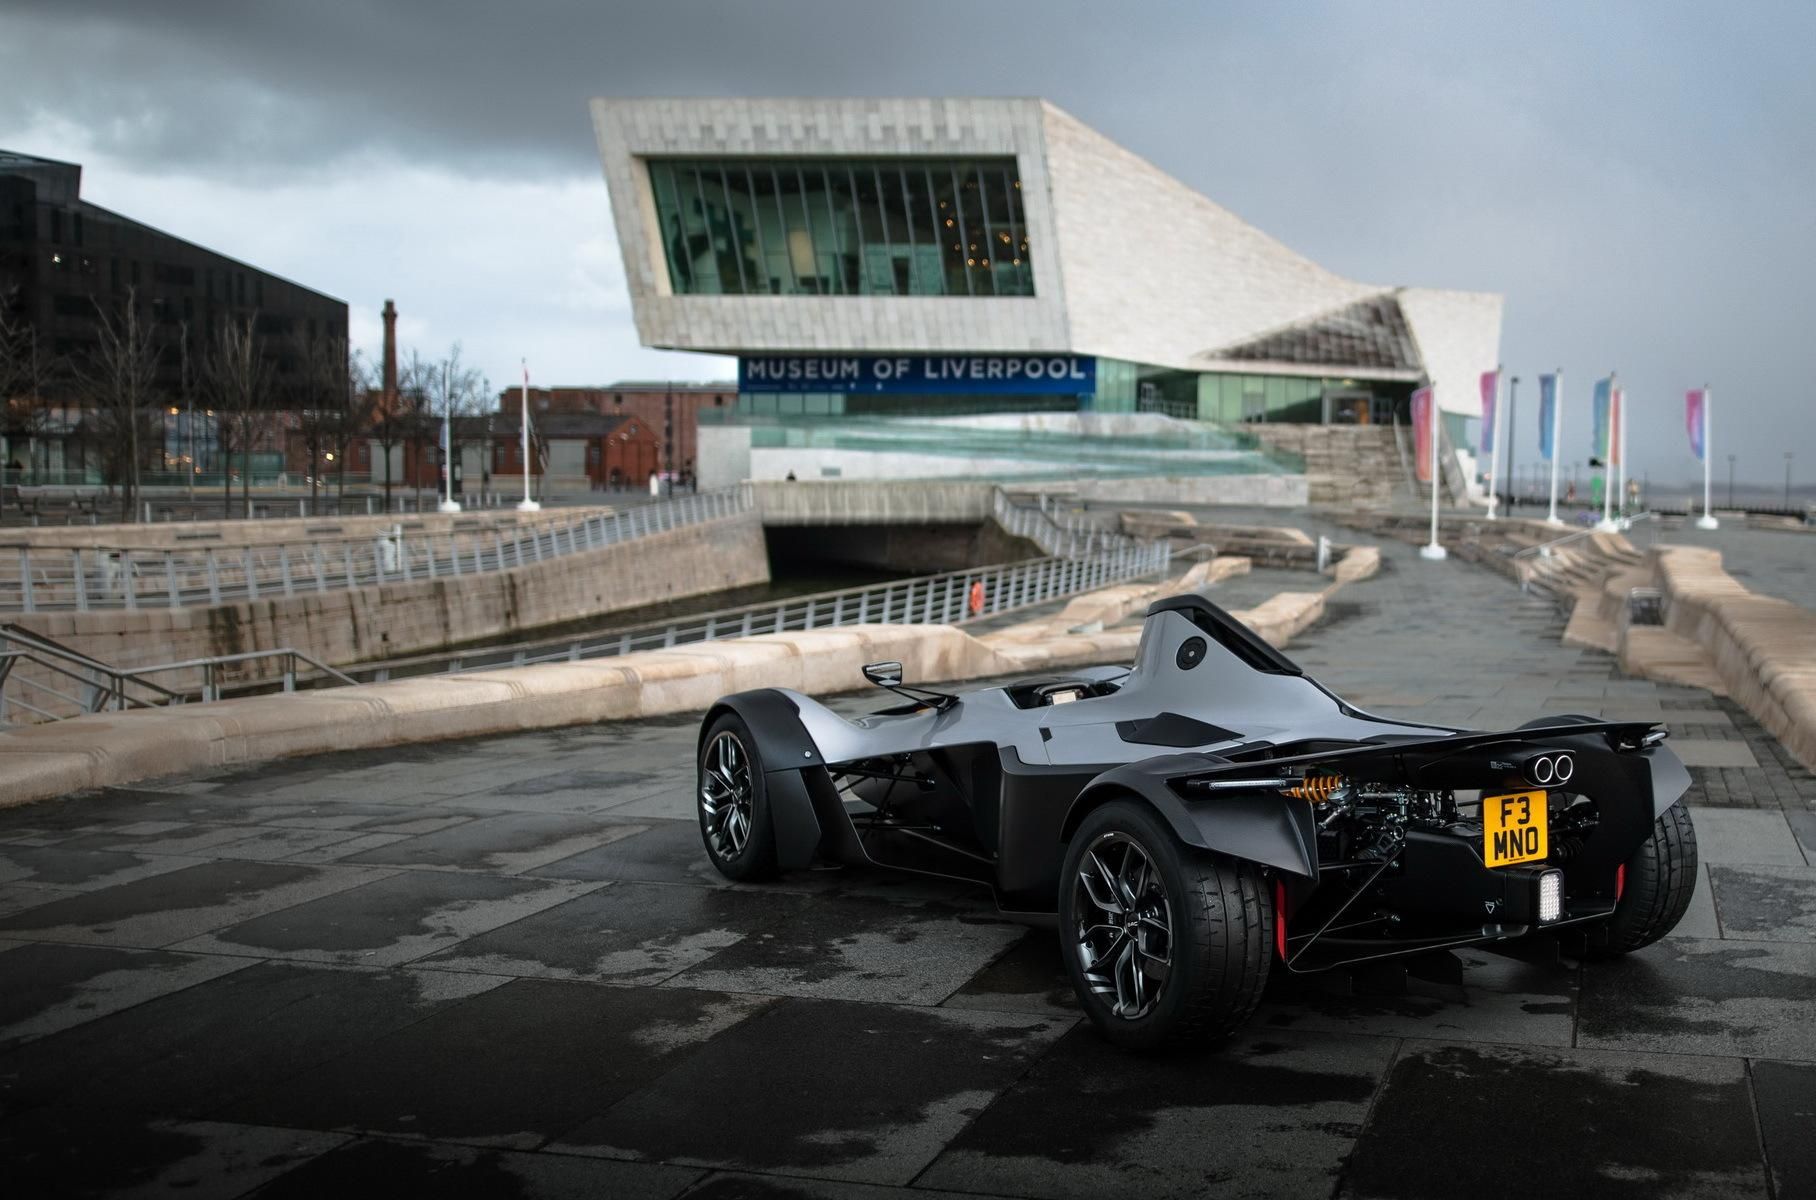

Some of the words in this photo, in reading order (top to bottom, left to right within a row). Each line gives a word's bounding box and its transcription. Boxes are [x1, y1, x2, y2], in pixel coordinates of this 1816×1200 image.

[748, 360, 859, 379] MUSEUM
[873, 360, 911, 379] OF
[924, 359, 1086, 379] LIVERPOOL
[1501, 797, 1531, 827] F3
[1494, 826, 1538, 860] MNO
